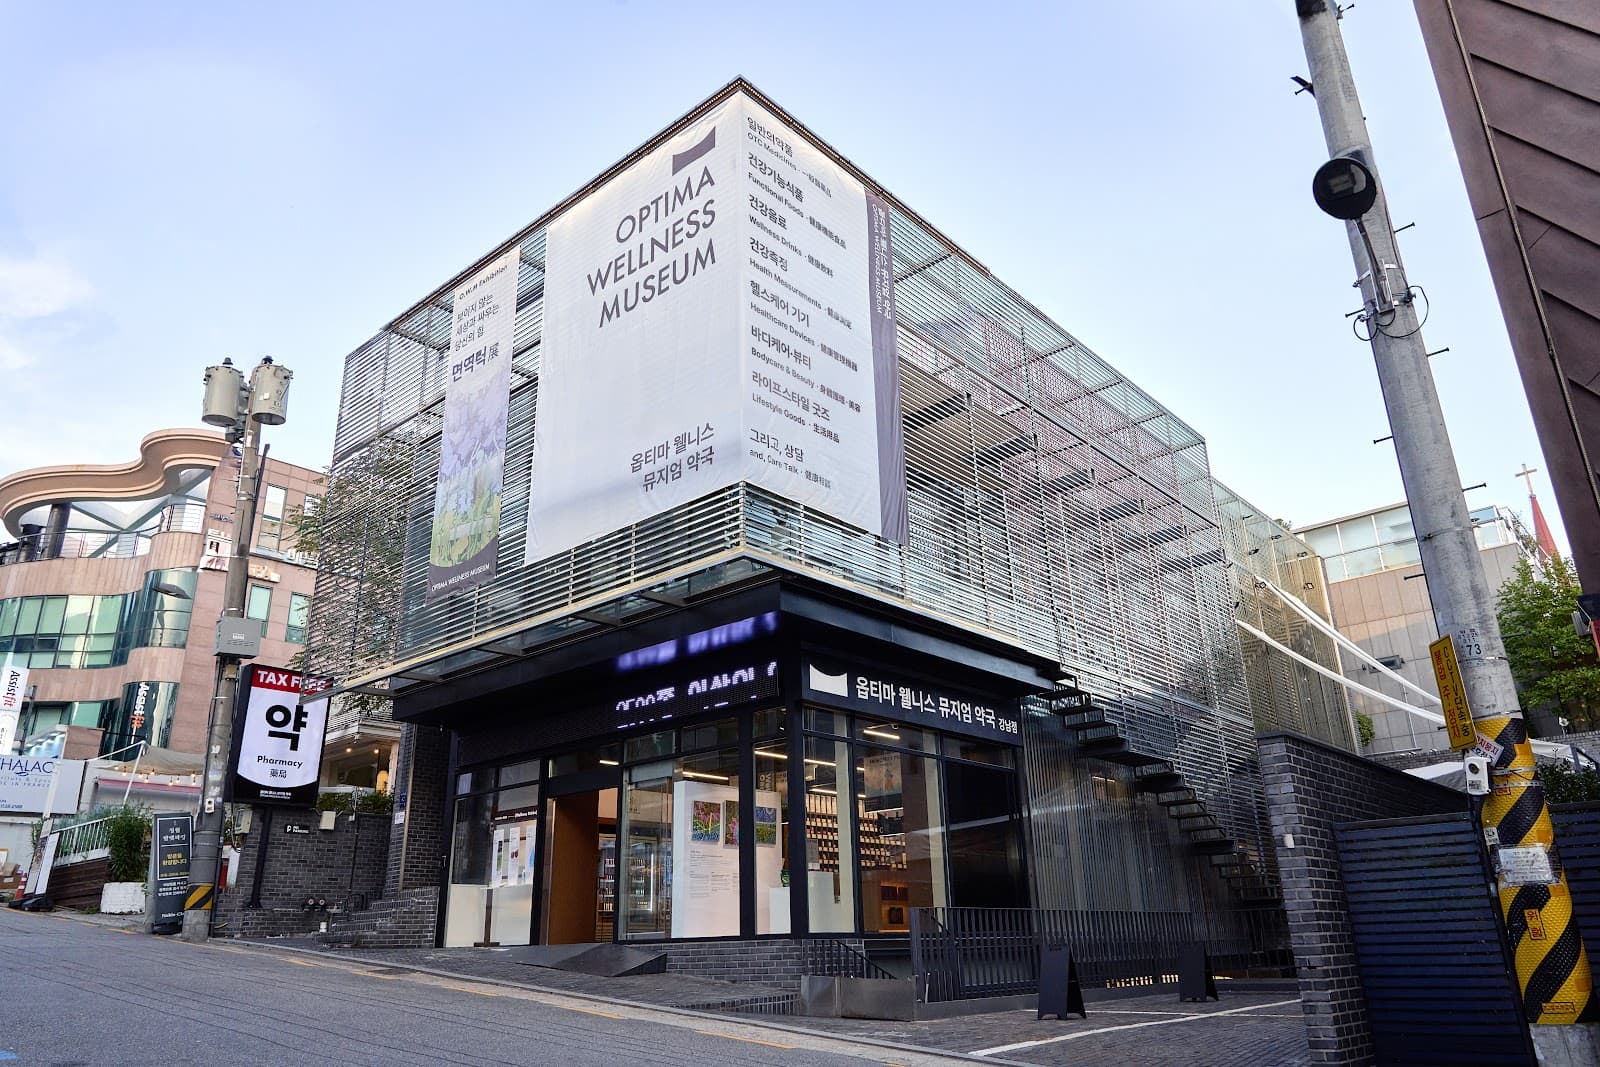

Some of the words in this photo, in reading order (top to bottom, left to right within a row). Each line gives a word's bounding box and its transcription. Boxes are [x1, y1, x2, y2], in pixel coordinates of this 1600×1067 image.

[747, 116, 793, 158] 일반의약품
[747, 132, 763, 147] OTC
[764, 142, 797, 171] Medicines
[748, 152, 804, 203] 건강기능식품
[748, 173, 783, 204] Functional
[784, 196, 804, 218] Foods
[616, 165, 716, 244] OPTIMA
[749, 194, 787, 231] 건강음료
[586, 199, 716, 297] WELLNESS
[749, 215, 780, 242] Wellness
[781, 237, 802, 258] Drinks
[749, 237, 788, 272] 건강측정
[478, 264, 508, 287] Exhibition
[599, 238, 716, 329] MUSEUM
[749, 258, 773, 280] Health
[774, 274, 822, 310] Measurements
[457, 300, 478, 323] 보이지
[750, 280, 789, 316] 헬스케어
[792, 305, 810, 328] 기기
[750, 302, 788, 331] Healthcare
[789, 325, 815, 347] Devices
[455, 331, 476, 352] 당신의
[477, 325, 485, 338] 힘
[456, 315, 478, 336] 세상과
[751, 347, 785, 372] Bodycare
[791, 368, 815, 389] Beauty
[751, 371, 810, 412] 라이프스타일
[811, 401, 831, 422] 굿즈
[752, 393, 783, 417] Lifestyle
[783, 409, 806, 427] Goods
[630, 437, 670, 473] 옵티마
[673, 422, 714, 455] 웰니스
[767, 455, 782, 470] Care
[783, 463, 799, 475] Talk
[784, 444, 804, 463] 상담
[643, 460, 684, 492] 뮤지엄
[686, 446, 715, 474] 약국
[431, 580, 448, 592] OPTIMA
[448, 571, 470, 585] WELLNESS
[470, 562, 490, 577] MUSEUM
[1465, 643, 1482, 657] 73
[257, 670, 289, 688] TAX
[855, 676, 896, 706] 옵티마
[898, 686, 937, 713] 웰니스
[938, 697, 972, 724] 뮤지엄
[974, 705, 996, 729] 약국
[998, 717, 1018, 735] 강남점
[265, 704, 309, 752] 약
[256, 755, 304, 769] Pharmacy
